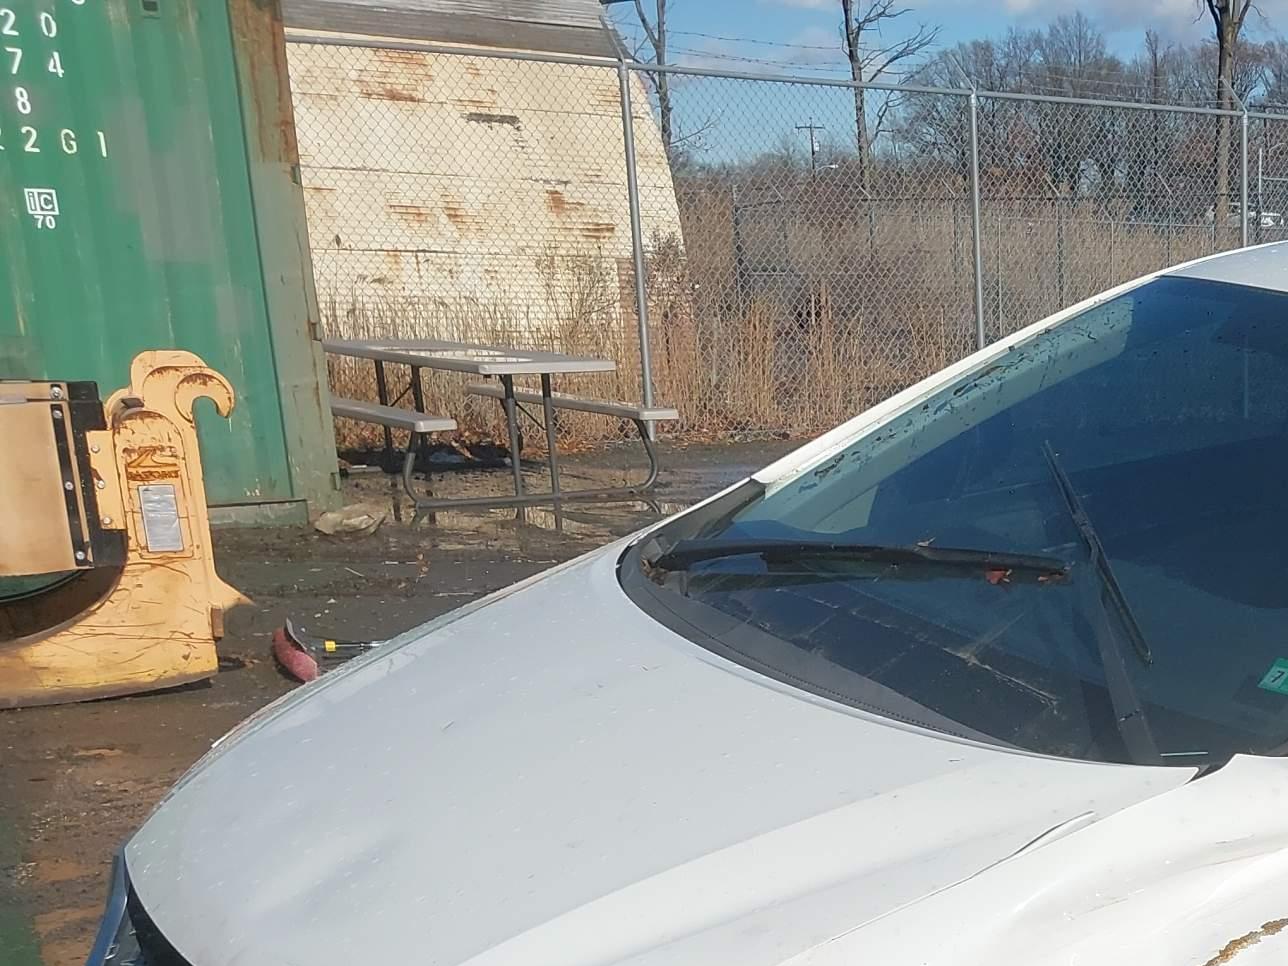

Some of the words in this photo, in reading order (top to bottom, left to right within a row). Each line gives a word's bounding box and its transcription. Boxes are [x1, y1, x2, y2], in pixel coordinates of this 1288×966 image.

[15, 86, 32, 115] 8
[34, 214, 56, 229] 70
[1271, 669, 1286, 684] 7
